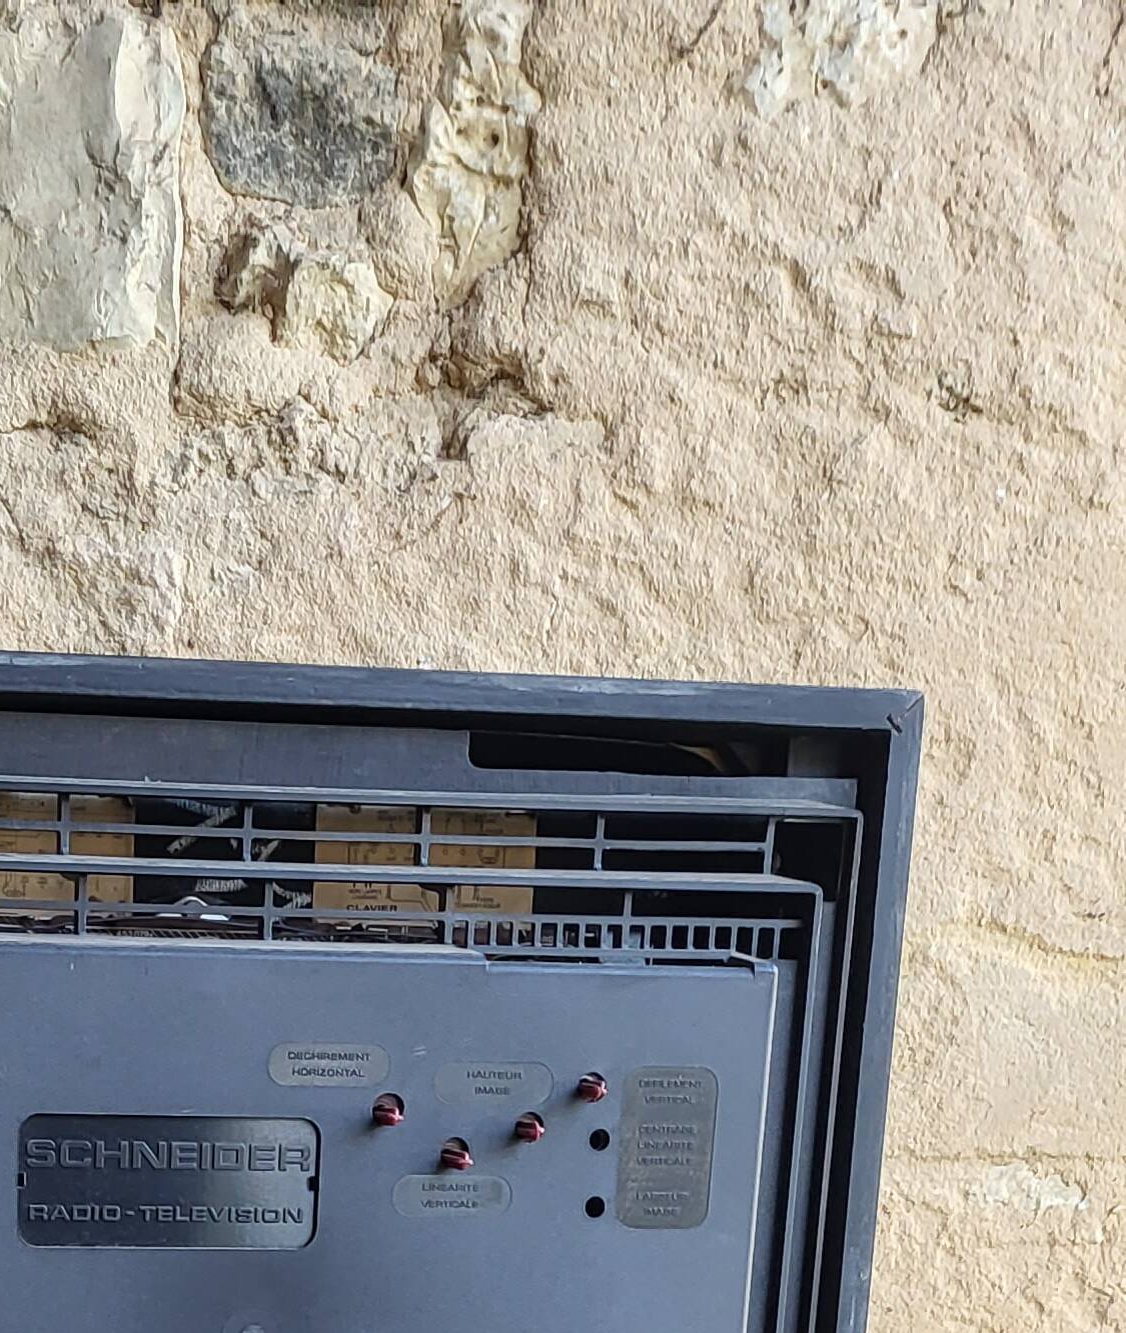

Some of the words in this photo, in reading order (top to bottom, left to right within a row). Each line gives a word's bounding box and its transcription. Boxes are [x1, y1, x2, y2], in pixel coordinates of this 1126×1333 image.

[287, 1051, 371, 1062] DECHIREMENT
[291, 1067, 366, 1078] HORIZONTAL
[467, 1070, 523, 1081] HAUTEUR
[474, 1086, 511, 1096] IMAGE
[26, 1138, 311, 1171] SCHNEIDER
[421, 1183, 479, 1194] LINEARITE
[421, 1199, 479, 1210] VERTICALE
